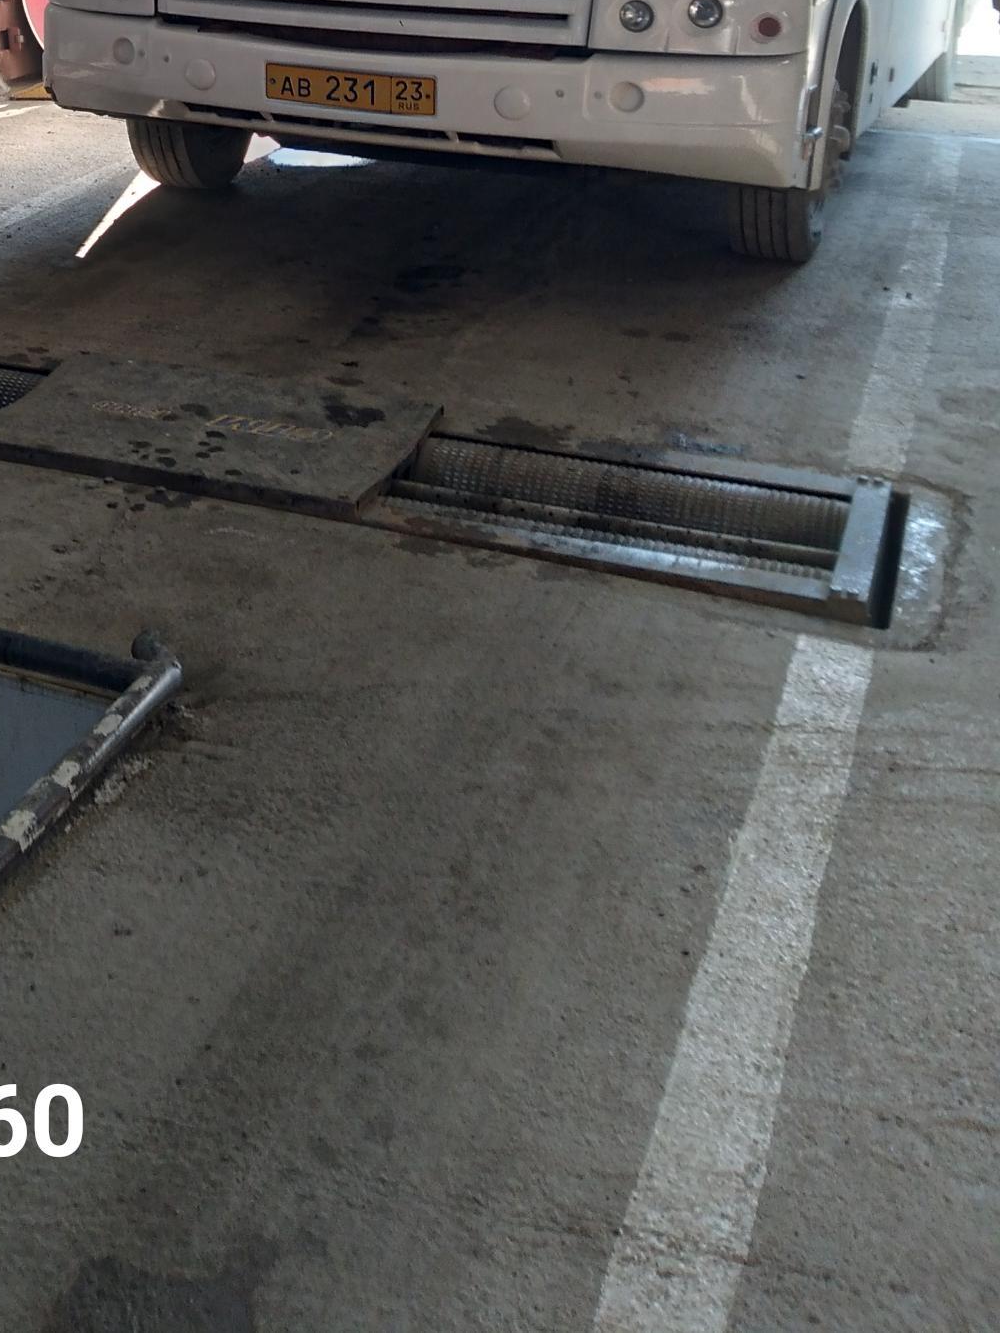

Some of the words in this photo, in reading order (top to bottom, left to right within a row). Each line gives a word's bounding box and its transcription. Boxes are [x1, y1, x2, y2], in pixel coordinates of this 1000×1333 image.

[325, 75, 376, 107] 231
[395, 80, 424, 101] 23
[398, 102, 421, 112] RUS
